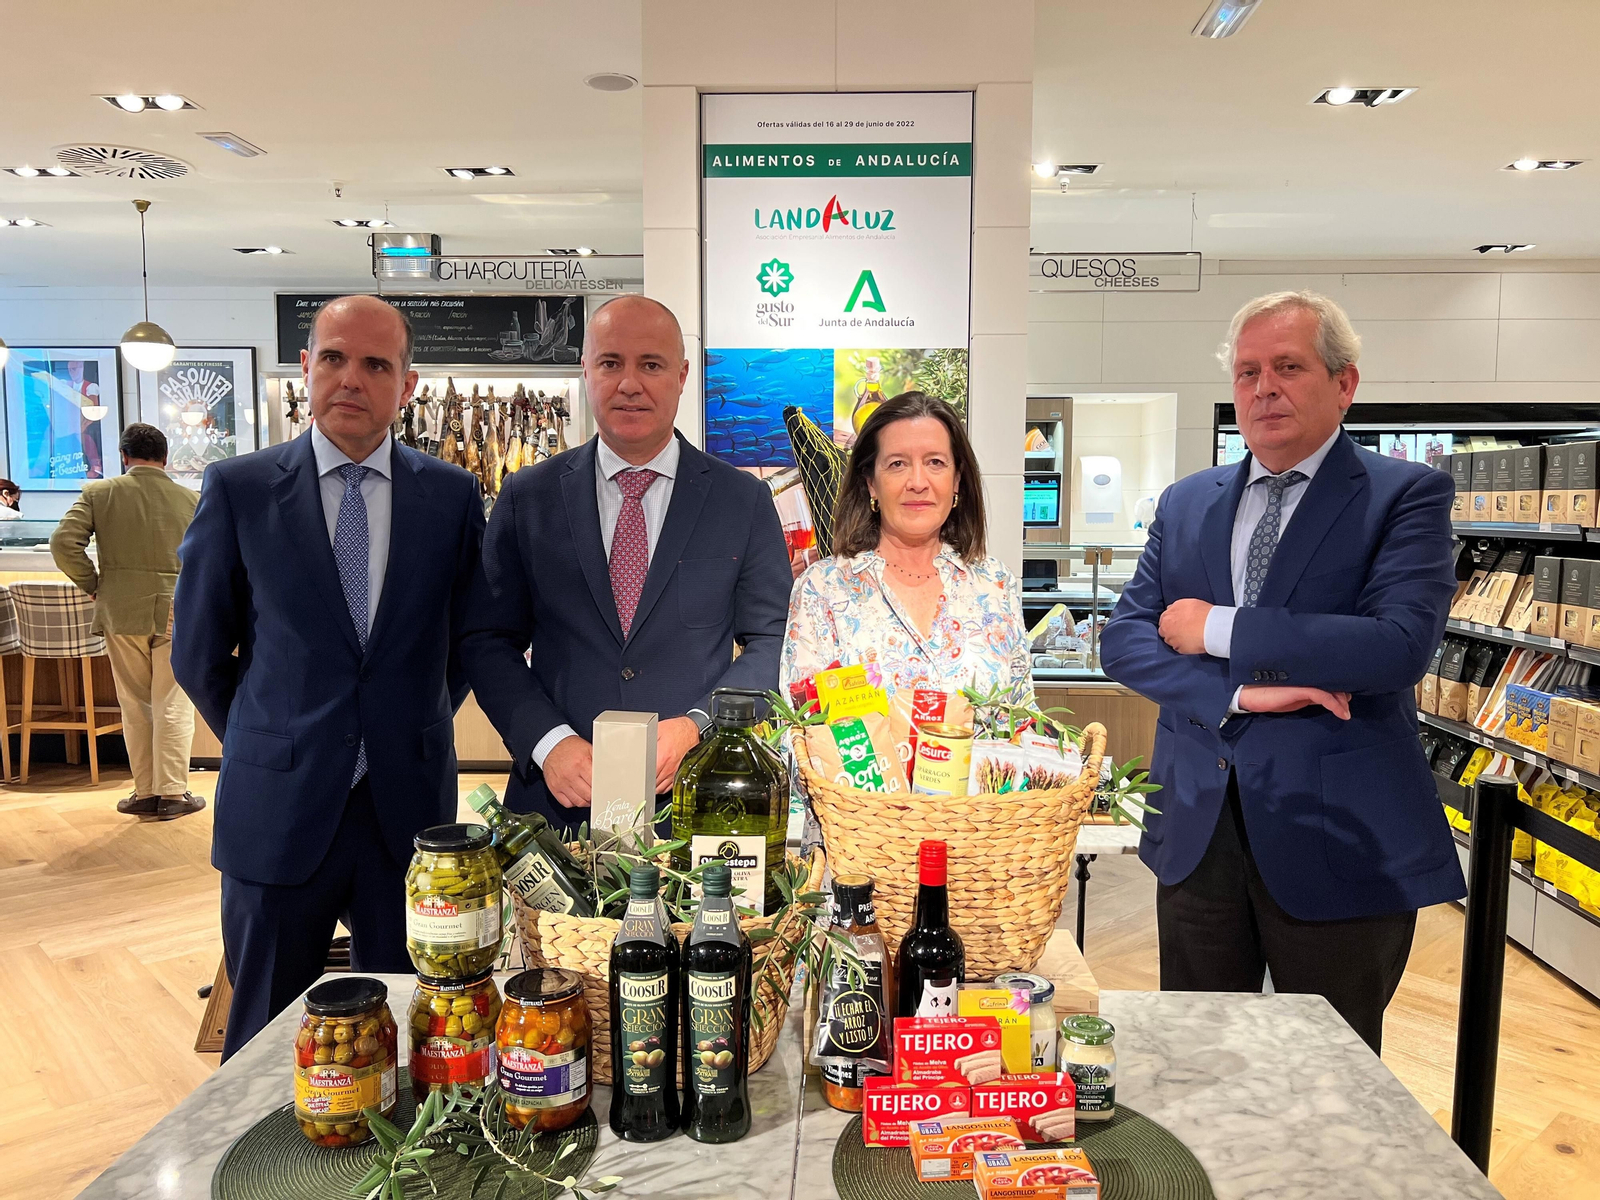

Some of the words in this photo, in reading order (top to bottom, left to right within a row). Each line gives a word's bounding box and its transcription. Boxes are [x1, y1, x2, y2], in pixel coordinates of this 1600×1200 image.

[712, 154, 816, 167] ALIMENTOS
[855, 151, 960, 166] ANDALUCÍA
[754, 194, 896, 233] LANDALUZ
[437, 260, 586, 281] CHARCUTERÍA
[1041, 258, 1136, 278] QUESOS
[525, 280, 624, 290] DELICATESSEN
[1094, 277, 1160, 288] CHEESES
[756, 300, 794, 318] gusto
[758, 317, 768, 325] del
[768, 313, 794, 327] Sur
[818, 318, 847, 327] Junta
[850, 318, 862, 327] de
[864, 317, 915, 327] Andalucía
[160, 367, 233, 398] PASQUIER
[171, 384, 222, 409] GIRAUD
[836, 690, 880, 706] AZAFRÁN
[839, 733, 866, 746] ARROZ
[920, 774, 941, 784] VERDES
[606, 798, 629, 812] Venta
[701, 857, 756, 867] Olestepa
[416, 904, 457, 916] MAESTRANZA
[630, 904, 652, 913] COOSUR
[413, 919, 427, 929] Gran
[703, 913, 728, 922] COOSUR
[625, 920, 654, 932] GRAN
[623, 979, 665, 997] COOSUR
[691, 981, 733, 998] COOSUR
[622, 1005, 666, 1025] GRAN
[841, 1002, 864, 1016] ECHAR
[864, 1000, 873, 1012] EL
[690, 1007, 734, 1025] GRAN
[844, 1015, 865, 1030] ARROZ
[839, 1033, 844, 1044] Y
[846, 1029, 866, 1044] LISTO
[867, 1026, 873, 1040] !!
[901, 1033, 973, 1054] TEJERO
[422, 1048, 464, 1058] MAESTRANZA
[503, 1056, 542, 1070] MAESTRANZA
[500, 1066, 513, 1078] Gran
[514, 1072, 547, 1081] Gourmet
[310, 1076, 352, 1087] MAESTRANZA
[322, 1088, 359, 1096] Gourmet
[869, 1094, 941, 1114] TEJERO
[975, 1091, 1047, 1112] TEJERO
[1081, 1102, 1100, 1111] oliva
[946, 1122, 1011, 1131] LANGOSTILLOS
